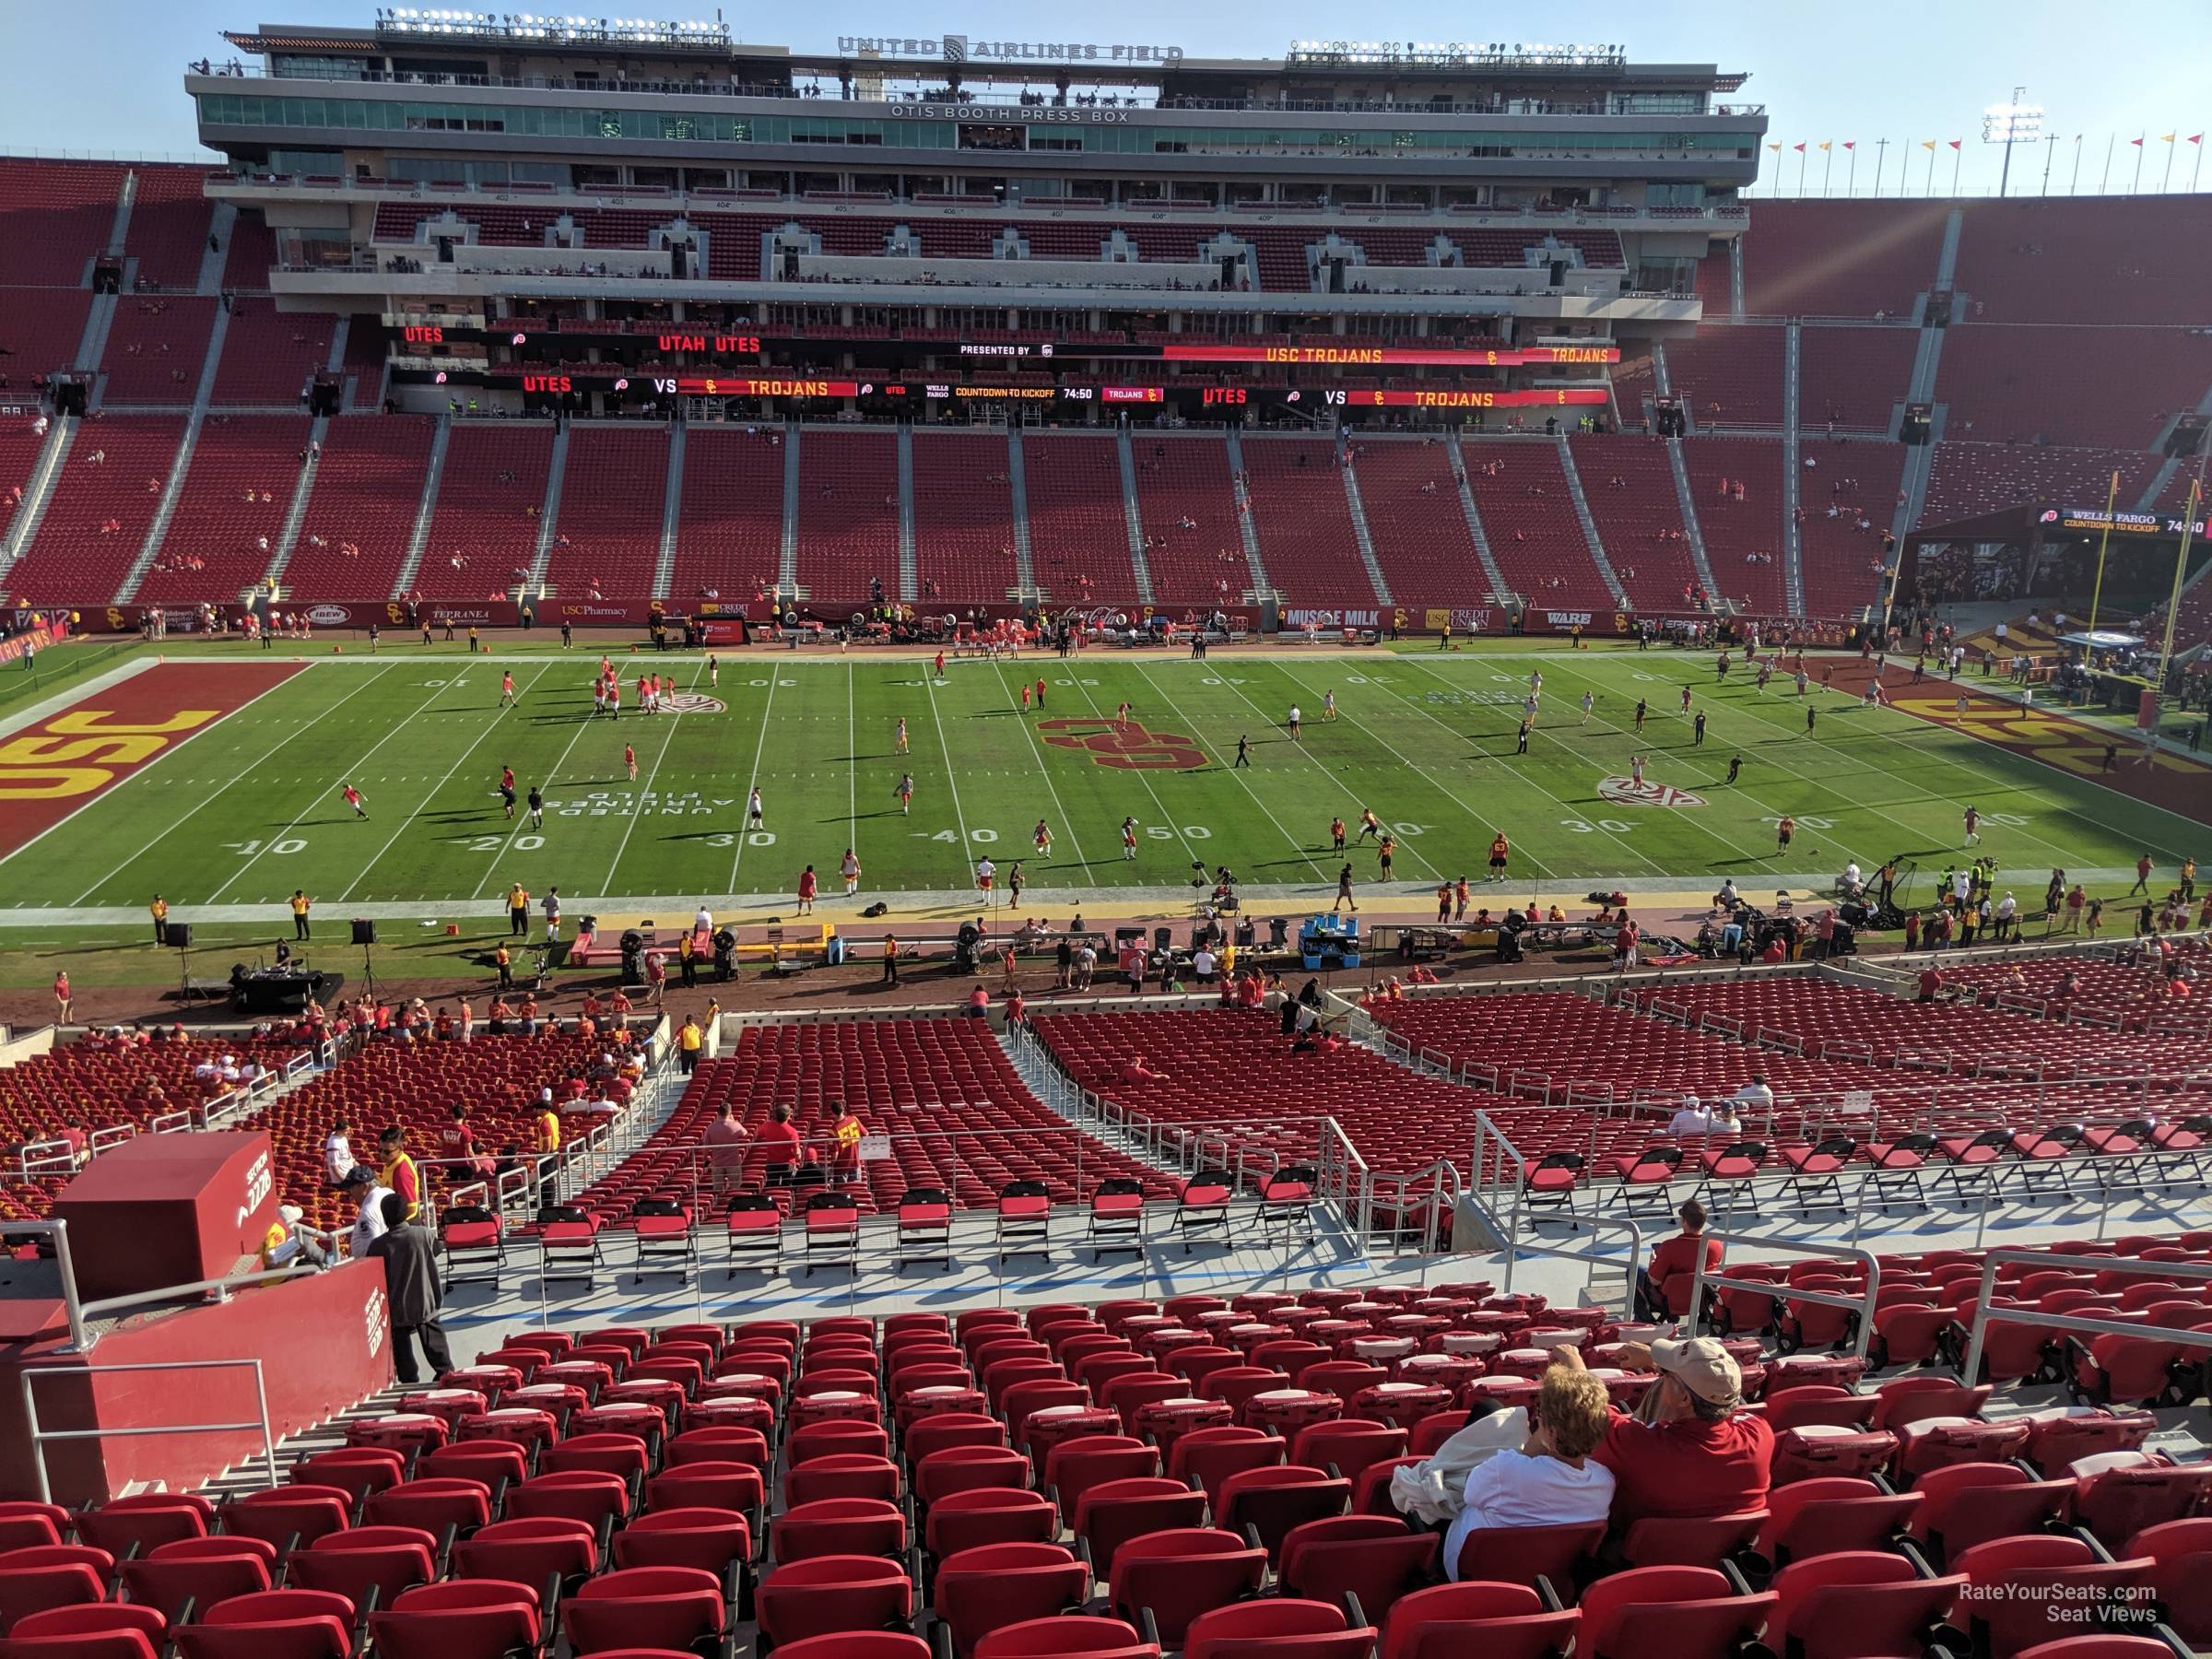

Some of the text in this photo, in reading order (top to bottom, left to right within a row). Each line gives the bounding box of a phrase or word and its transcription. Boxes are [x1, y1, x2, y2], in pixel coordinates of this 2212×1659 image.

[838, 36, 1183, 61] UNITED AIRLINES FIELD
[891, 105, 1129, 123] OTIS BOOTH PRESS BOX
[405, 327, 442, 342] UTES
[659, 335, 760, 352] UTAH UTES
[960, 346, 1014, 355] PRESENTED
[1018, 347, 1030, 355] BY
[1267, 347, 1382, 363] USC TROJANS
[1552, 348, 1607, 362] TROJANS
[524, 376, 571, 392] UTES
[654, 379, 677, 393] VS
[747, 381, 828, 395] TROJANS
[886, 386, 905, 394] UTES
[956, 387, 1007, 396] COUNTDOWN
[1021, 389, 1055, 397] KICKOFF
[1064, 389, 1092, 399] 74:50
[1204, 388, 1246, 404] UTES
[1324, 391, 1346, 405] VS
[1415, 392, 1493, 406] TROJANS
[2073, 511, 2156, 524] WELLS FARGO
[2127, 524, 2160, 533] KICKOFF
[1921, 544, 1936, 554] 34
[1980, 544, 1990, 554] 11
[386, 604, 404, 623] SC
[432, 610, 489, 618] TERRANEA
[1345, 611, 1378, 625] MILK
[1427, 613, 1449, 623] USC
[1451, 609, 1491, 618] CREDIT
[1547, 613, 1592, 624] WARE
[1615, 614, 1628, 632] SC
[544, 799, 735, 807] AIRLINES
[559, 807, 712, 816] UNITED
[1147, 826, 1213, 840] 50
[1559, 819, 1633, 833] 30
[468, 836, 547, 851] 20
[706, 832, 777, 847] 30
[931, 829, 999, 844] 40
[236, 840, 309, 853] 10
